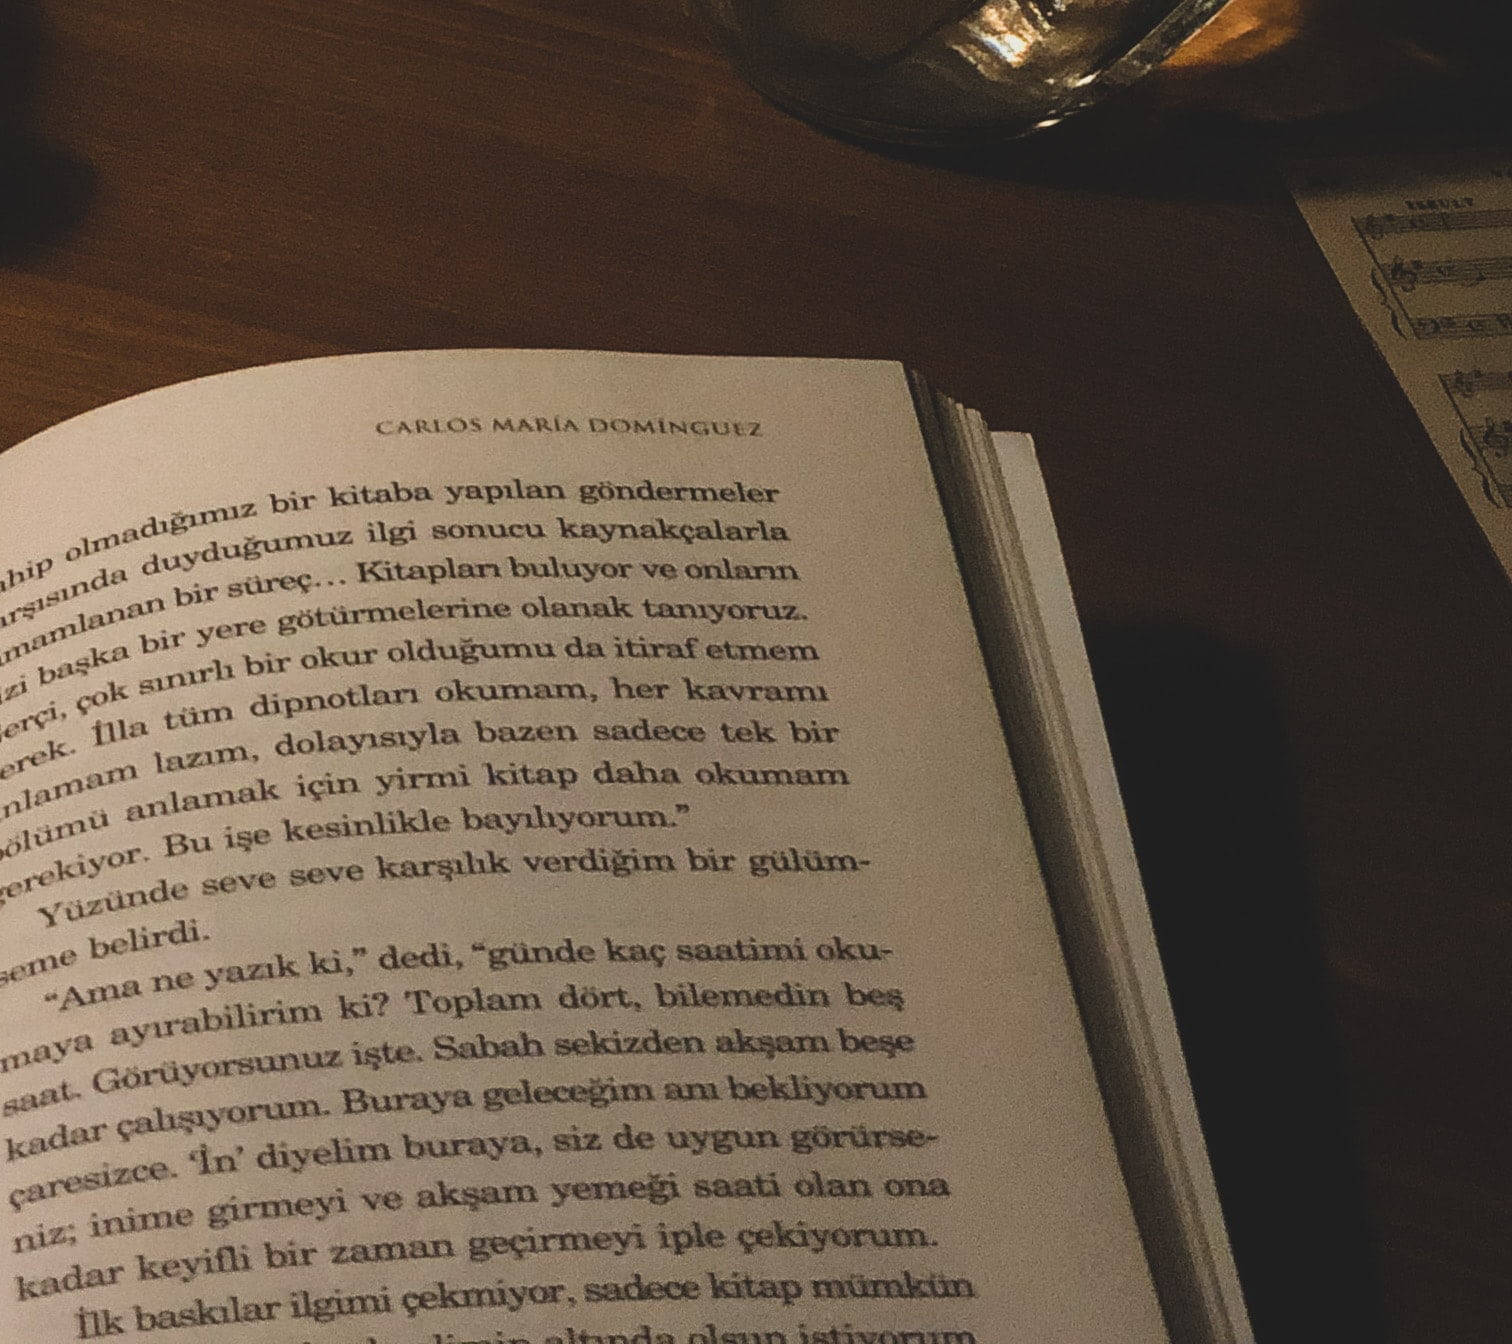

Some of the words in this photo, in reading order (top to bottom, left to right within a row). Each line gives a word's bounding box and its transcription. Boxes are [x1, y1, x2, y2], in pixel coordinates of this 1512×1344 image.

[375, 417, 483, 436] CARLOS
[268, 489, 318, 515] bir
[327, 480, 434, 508] kitaba
[366, 518, 418, 548] ilgi
[431, 522, 547, 542] sonucu
[37, 645, 130, 687] başka
[138, 628, 186, 655] bir
[196, 618, 267, 650] yere
[520, 594, 634, 620] olanak
[75, 679, 130, 717] çok
[241, 650, 292, 677] bir
[299, 645, 379, 671] okur
[386, 636, 557, 666] olduğumu
[563, 634, 607, 660] da
[613, 635, 700, 661] itiraf
[705, 639, 821, 662] etmem
[163, 704, 234, 732] tüm
[608, 674, 671, 701] her
[125, 777, 281, 824] anlamak
[295, 771, 362, 804] için
[374, 762, 471, 798] yirmi
[481, 761, 579, 792] kitap
[592, 759, 682, 787] daha
[694, 760, 851, 788] okumam
[162, 831, 214, 859] Bu
[224, 825, 271, 854] işe
[151, 970, 195, 994] ne
[603, 936, 667, 970] kaç
[675, 936, 809, 964] saatimi
[432, 1030, 547, 1062] Sabah
[553, 1027, 707, 1058] sekizden
[715, 1027, 834, 1061] akşam
[835, 1026, 916, 1060] beşe
[255, 1136, 393, 1175] diyelim
[552, 1124, 603, 1153] siz
[612, 1122, 656, 1152] de
[664, 1128, 783, 1157] uygun
